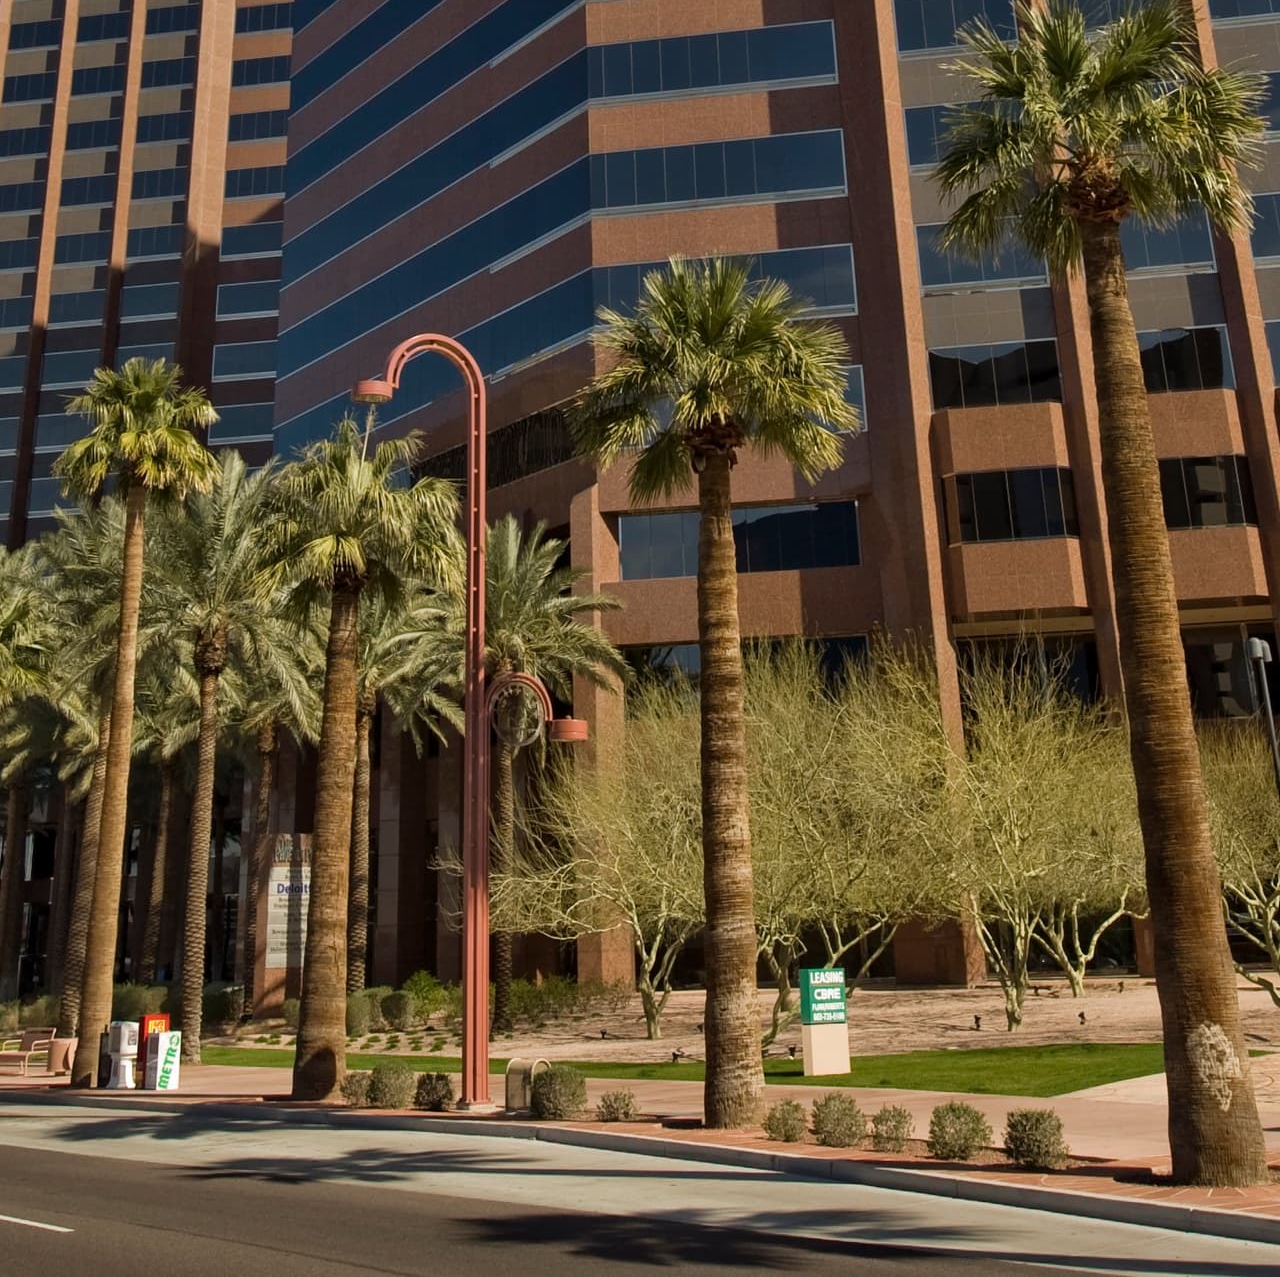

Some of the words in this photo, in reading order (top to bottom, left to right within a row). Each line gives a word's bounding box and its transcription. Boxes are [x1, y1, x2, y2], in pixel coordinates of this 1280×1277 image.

[276, 883, 311, 895] Deloit
[810, 971, 844, 984] LEASING
[814, 987, 841, 1001] CBRE
